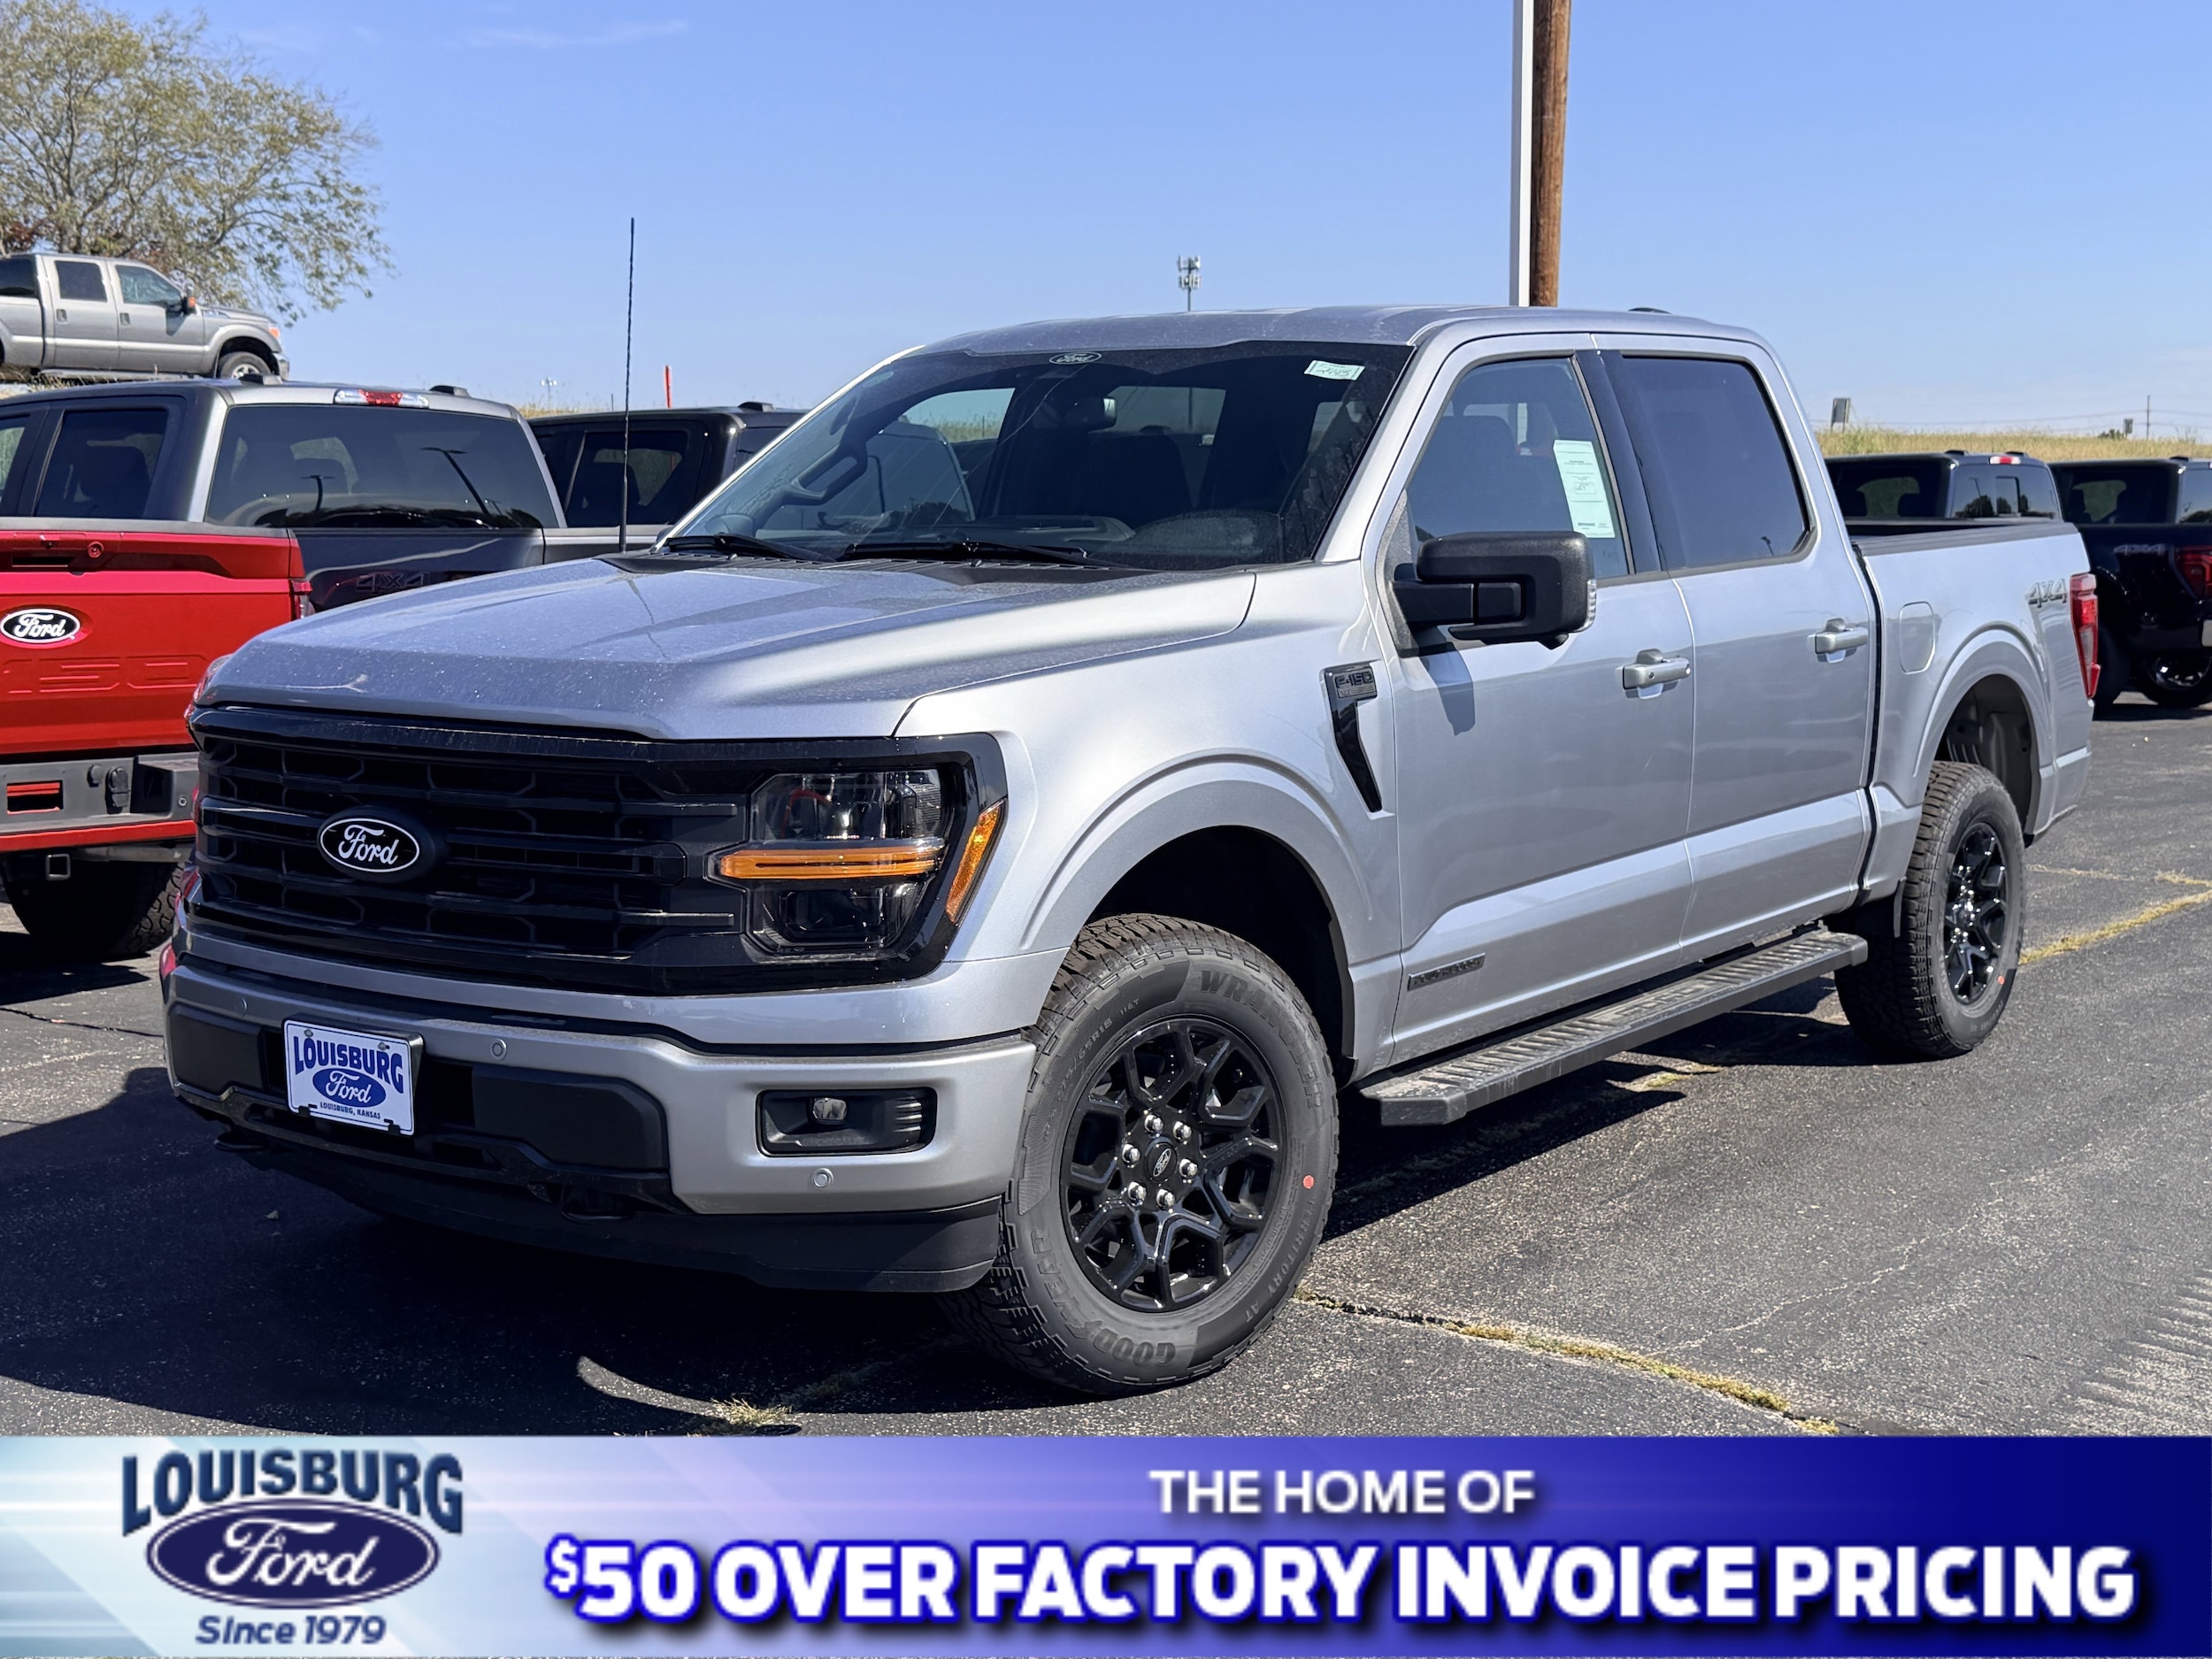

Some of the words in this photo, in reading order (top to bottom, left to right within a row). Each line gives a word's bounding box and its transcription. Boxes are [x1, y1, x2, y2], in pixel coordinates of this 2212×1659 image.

[14, 613, 66, 637] Ford
[1334, 672, 1373, 688] F-150
[338, 825, 399, 864] Ford
[1201, 970, 1325, 1109] WRANGLER
[293, 1036, 404, 1094] LOUISBURG
[326, 1071, 372, 1103] Ford
[319, 1101, 356, 1116] LOUISBURG,
[357, 1109, 380, 1119] KANSAS
